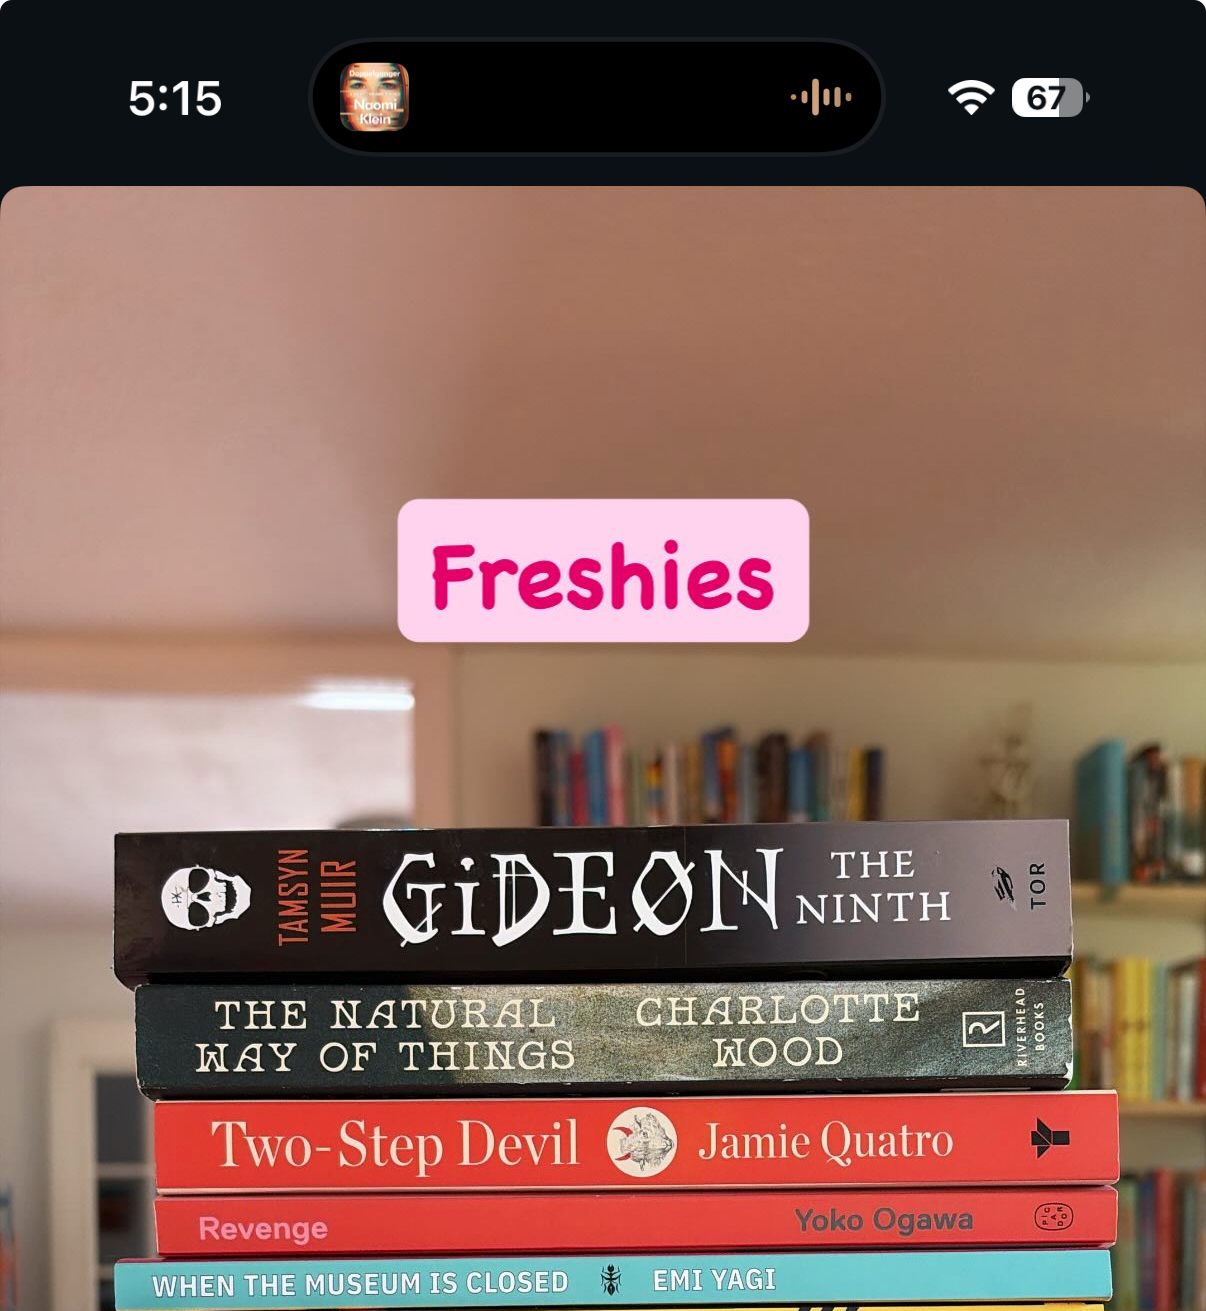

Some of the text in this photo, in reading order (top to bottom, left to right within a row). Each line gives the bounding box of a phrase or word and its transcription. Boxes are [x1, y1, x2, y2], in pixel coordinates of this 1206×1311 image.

[830, 850, 915, 879] THE
[278, 849, 309, 946] TAMSYN
[320, 860, 357, 933] MUIR
[1029, 863, 1046, 910] TOR
[796, 891, 951, 924] NINTH
[214, 999, 556, 1030] THE NATURAL
[636, 993, 920, 1027] CHARLOTTE
[1034, 1002, 1045, 1051] BOOKS
[1015, 988, 1028, 1067] RIVERHEAD
[195, 1040, 575, 1073] WAY OF THINGS
[712, 1036, 843, 1068] WOOD
[211, 1118, 580, 1178] Two-Step Devil
[699, 1120, 954, 1167] Jamie Quatro
[199, 1216, 329, 1246] Revenge
[795, 1207, 974, 1237] Yoko Ogawa
[152, 1270, 569, 1298] WHEN THE MUSEUM IS CLOSED
[653, 1267, 776, 1292] EMI YAGI
